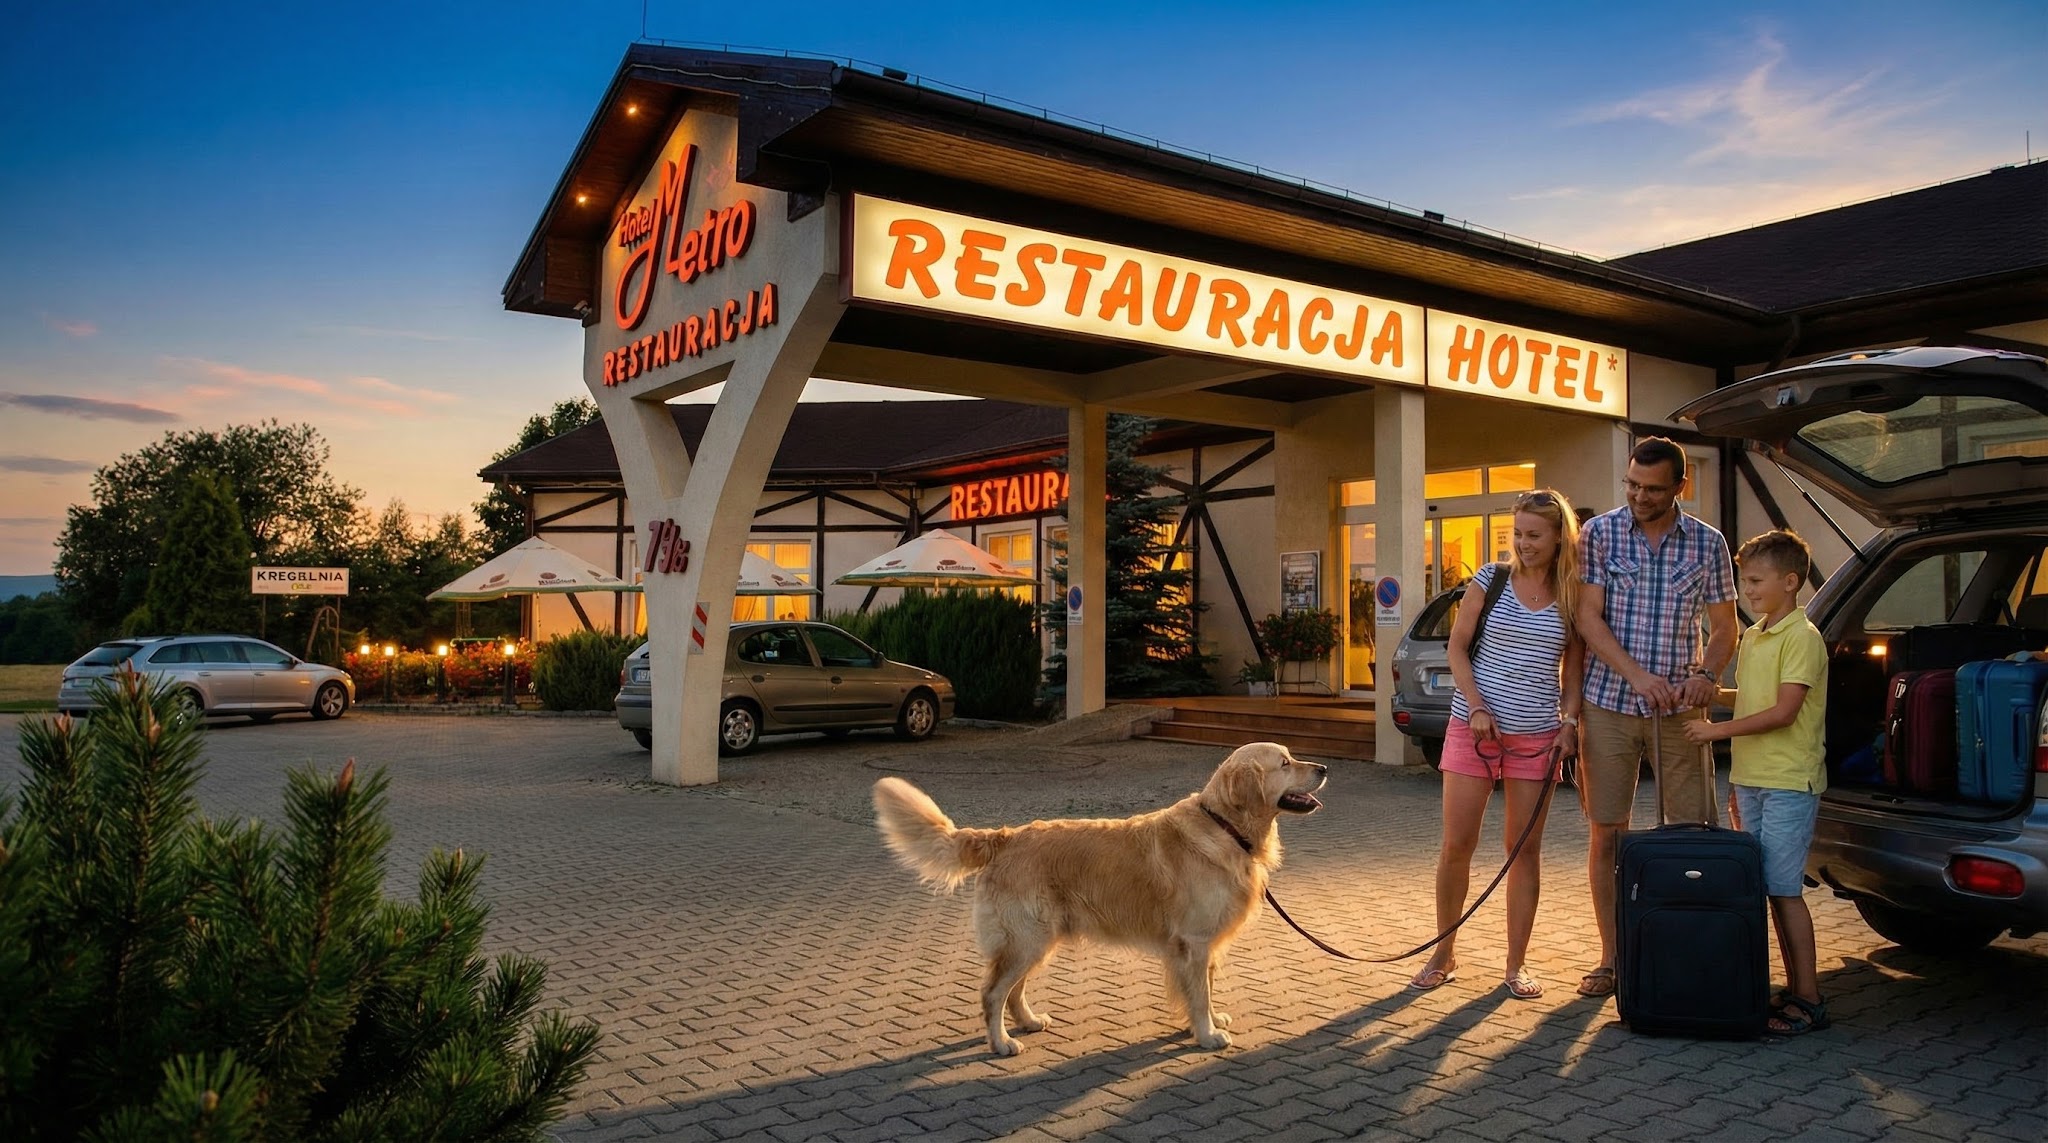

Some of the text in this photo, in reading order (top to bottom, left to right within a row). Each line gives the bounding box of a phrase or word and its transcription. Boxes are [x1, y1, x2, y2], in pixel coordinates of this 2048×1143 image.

[615, 144, 756, 330] Metro
[619, 205, 653, 247] Hotel
[603, 282, 778, 387] RESTAURACJA
[885, 219, 1404, 368] RESTAURACJA
[1448, 325, 1604, 403] HOTEL
